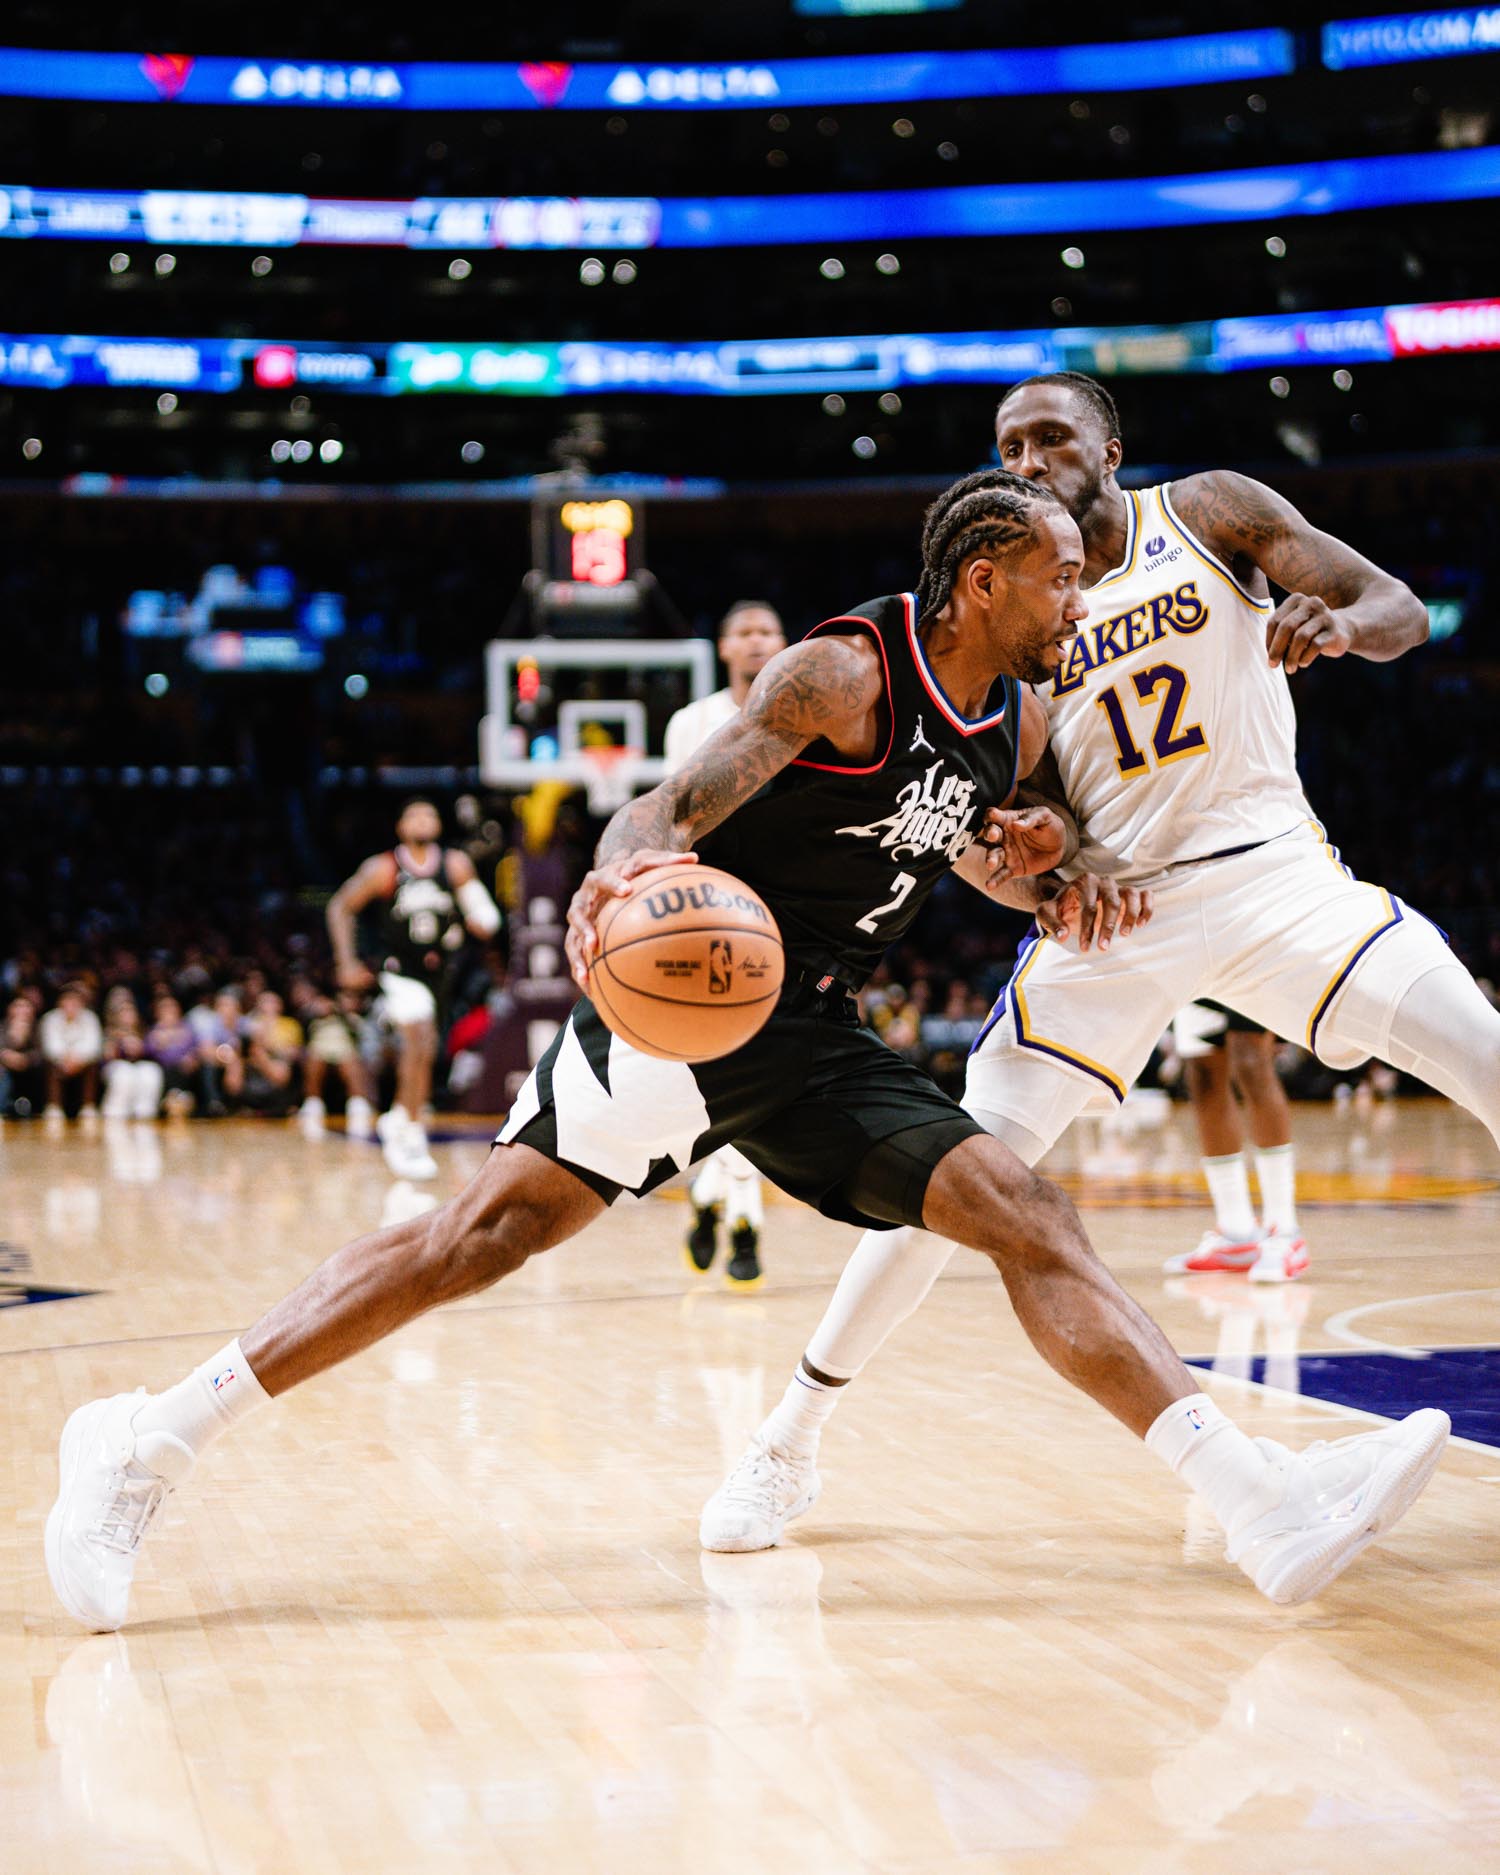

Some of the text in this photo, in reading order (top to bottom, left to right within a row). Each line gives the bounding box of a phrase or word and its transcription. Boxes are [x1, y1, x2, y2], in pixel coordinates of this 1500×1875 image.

[1144, 545, 1183, 573] bibigo
[1050, 581, 1209, 700] LAKERS
[1095, 660, 1210, 781] 12
[914, 759, 977, 817] Los
[835, 780, 977, 862] Angele
[643, 882, 770, 925] Wilson
[855, 871, 917, 934] 2
